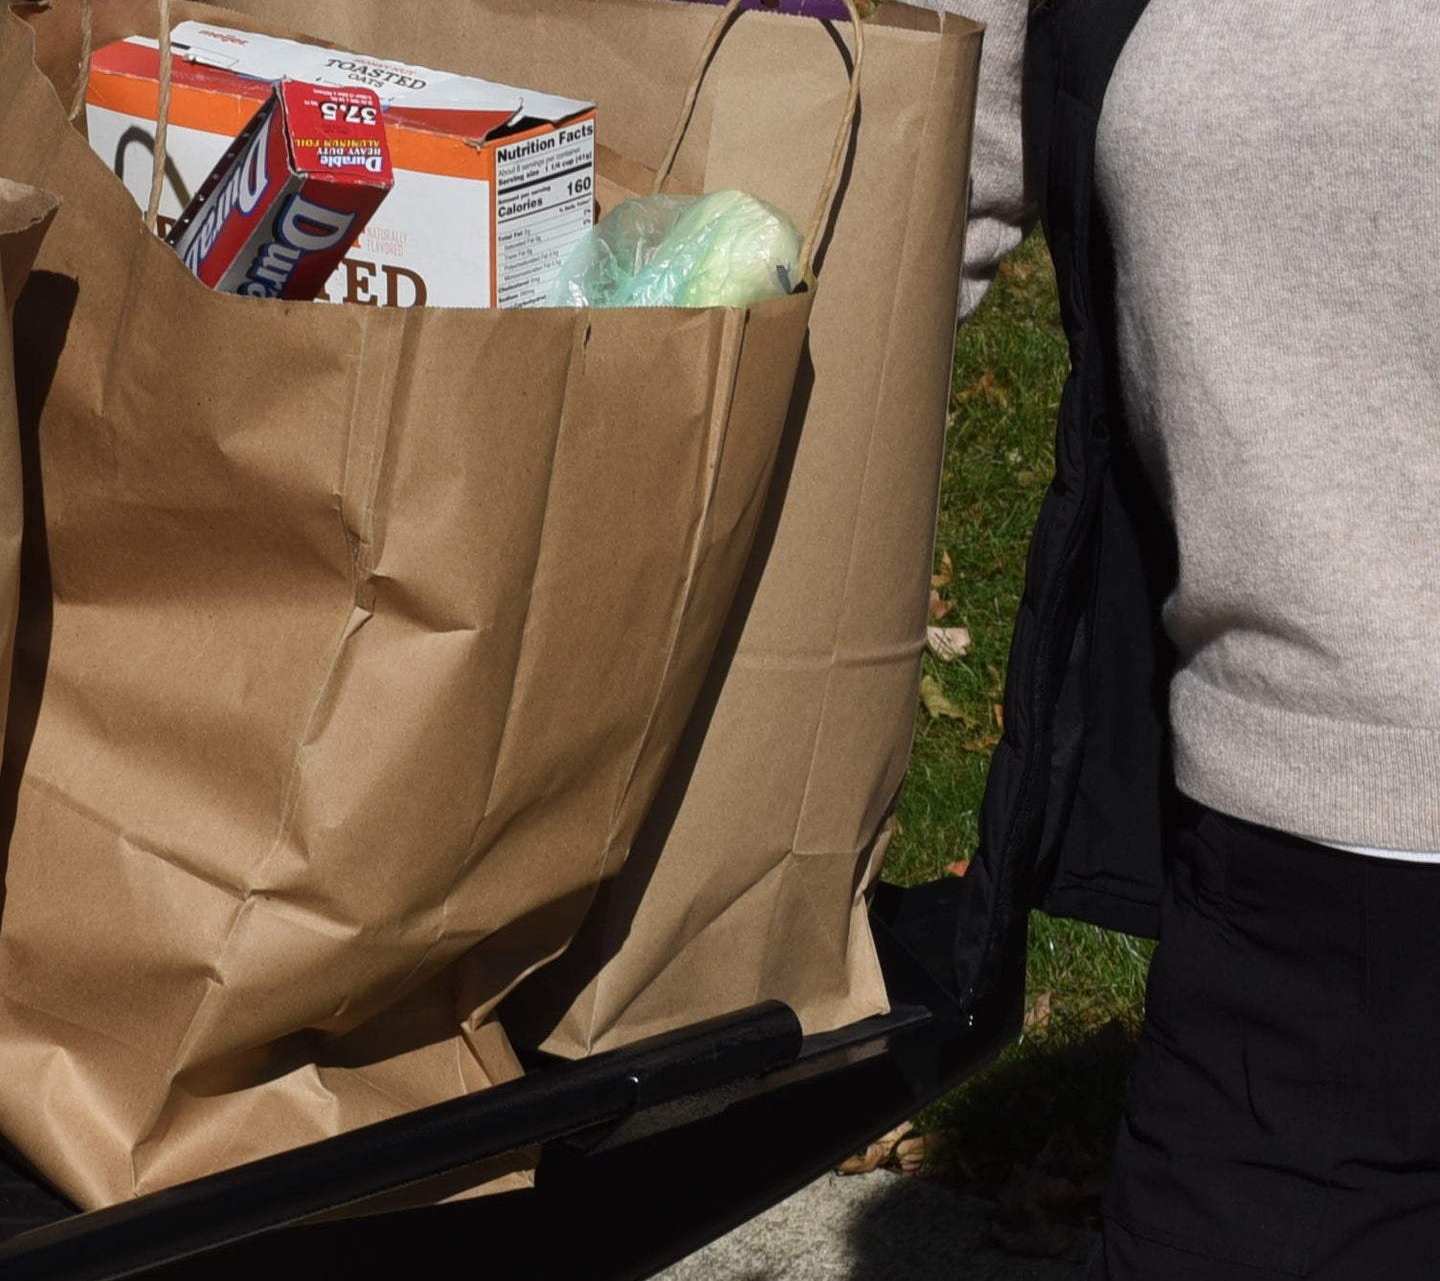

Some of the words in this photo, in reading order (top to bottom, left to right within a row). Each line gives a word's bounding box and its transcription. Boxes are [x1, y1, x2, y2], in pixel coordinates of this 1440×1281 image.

[198, 29, 250, 46] meijer
[324, 58, 427, 90] TOASTED
[348, 73, 384, 89] OATS
[320, 101, 378, 126] 37.5
[295, 138, 320, 147] FOIL
[317, 147, 344, 155] DUTY
[323, 139, 380, 148] ALUMINUM
[497, 138, 556, 164] Nutrition
[558, 124, 593, 146] Facts
[346, 148, 382, 156] HEAVY
[319, 155, 383, 173] Durable
[498, 174, 525, 187] Serving
[527, 169, 540, 179] size
[551, 161, 561, 171] 1/4
[562, 158, 575, 168] cup
[498, 197, 543, 218] Calories
[567, 176, 592, 196] 160
[367, 227, 408, 245] NATURALLY
[367, 238, 404, 257] FLAVORED
